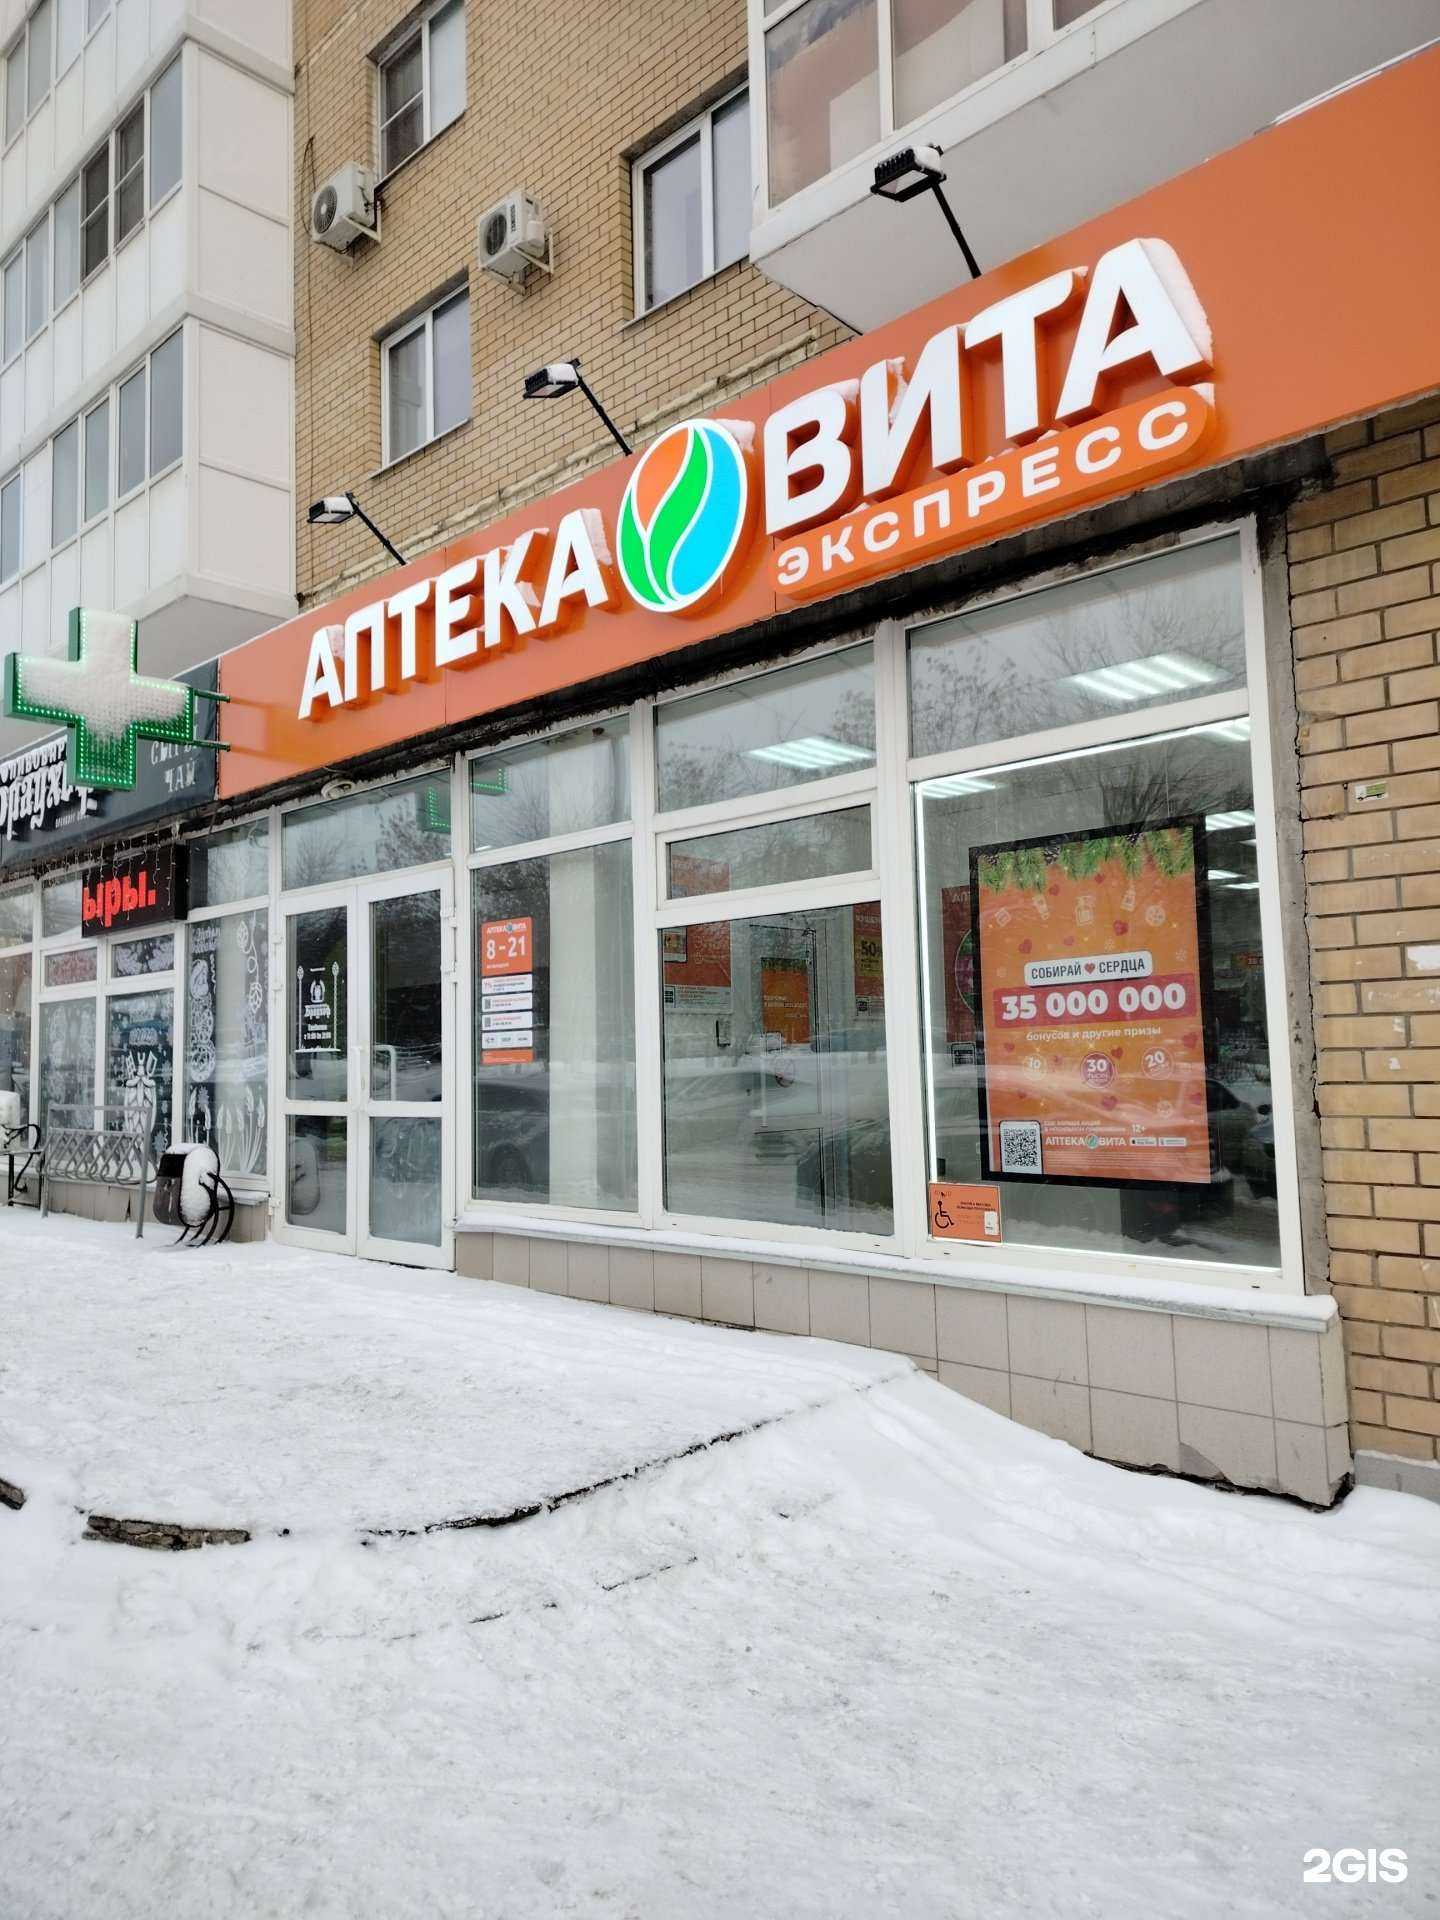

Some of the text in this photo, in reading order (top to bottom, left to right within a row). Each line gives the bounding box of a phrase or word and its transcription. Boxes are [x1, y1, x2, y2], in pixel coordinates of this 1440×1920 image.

[763, 238, 1204, 535] ВИТА
[777, 401, 1188, 585] ЭКСПРЕСС
[298, 508, 609, 719] АПТЕКА
[1031, 957, 1146, 980] СОБИРАЙ СЕРДЦА
[1001, 982, 1186, 1021] 35 000 000
[1026, 1026, 1161, 1042] бонусов и другие призы
[1086, 1059, 1107, 1073] 30
[1144, 1050, 1166, 1069] 20
[1131, 1123, 1146, 1134] 12+
[1045, 1136, 1087, 1146] АПТЕКА
[1099, 1136, 1127, 1146] ВИТА
